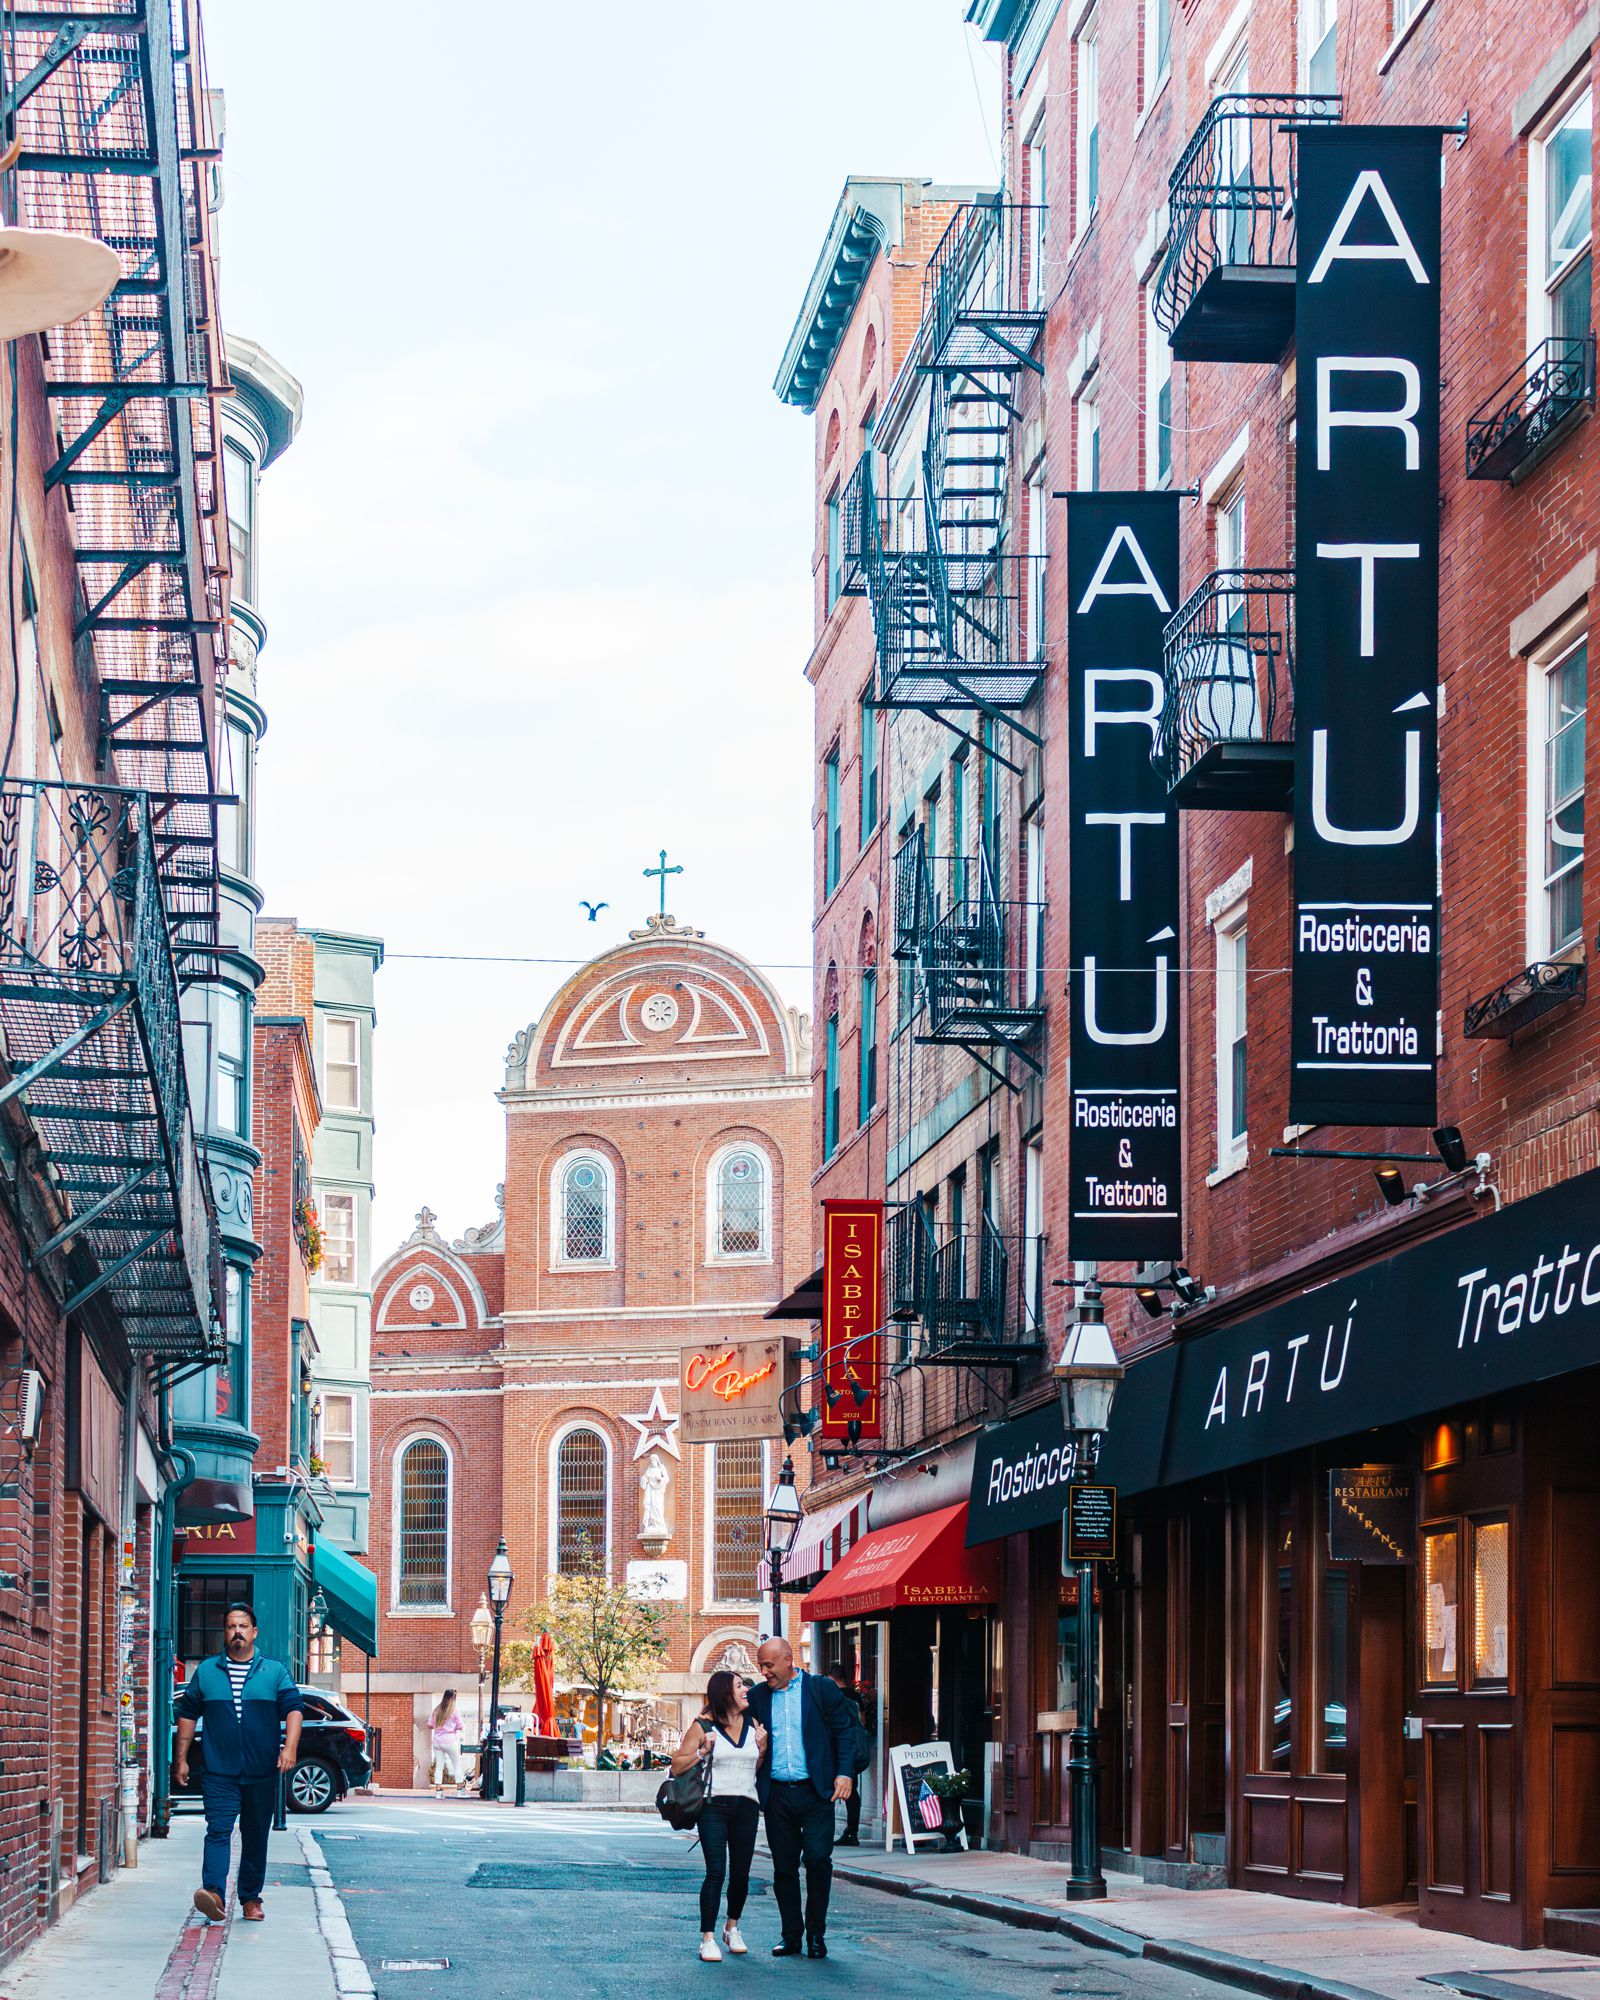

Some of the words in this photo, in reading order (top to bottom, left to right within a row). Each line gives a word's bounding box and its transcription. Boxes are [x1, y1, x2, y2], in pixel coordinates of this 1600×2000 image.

[1307, 170, 1431, 846] ARTÚ
[1298, 914, 1431, 954] Rosticceria
[1355, 968, 1374, 1006] &
[1312, 1016, 1418, 1055] Trattoria
[1075, 1098, 1176, 1128] Rosticceria
[1118, 1138, 1133, 1168] &
[1085, 1176, 1168, 1207] Trattoria
[840, 1223, 864, 1380] ISABELLA
[685, 1350, 735, 1390] Ciao
[712, 1362, 775, 1400] Roma
[1204, 1298, 1358, 1431] ARTÚ
[987, 1432, 1101, 1507] Rosticcera
[1335, 1487, 1409, 1498] RESTAURANT
[1341, 1498, 1405, 1558] ENTRANCE
[903, 1585, 989, 1595] ISABELLA
[909, 1594, 981, 1602] RISTORANTE
[904, 1750, 939, 1760] PERONI
